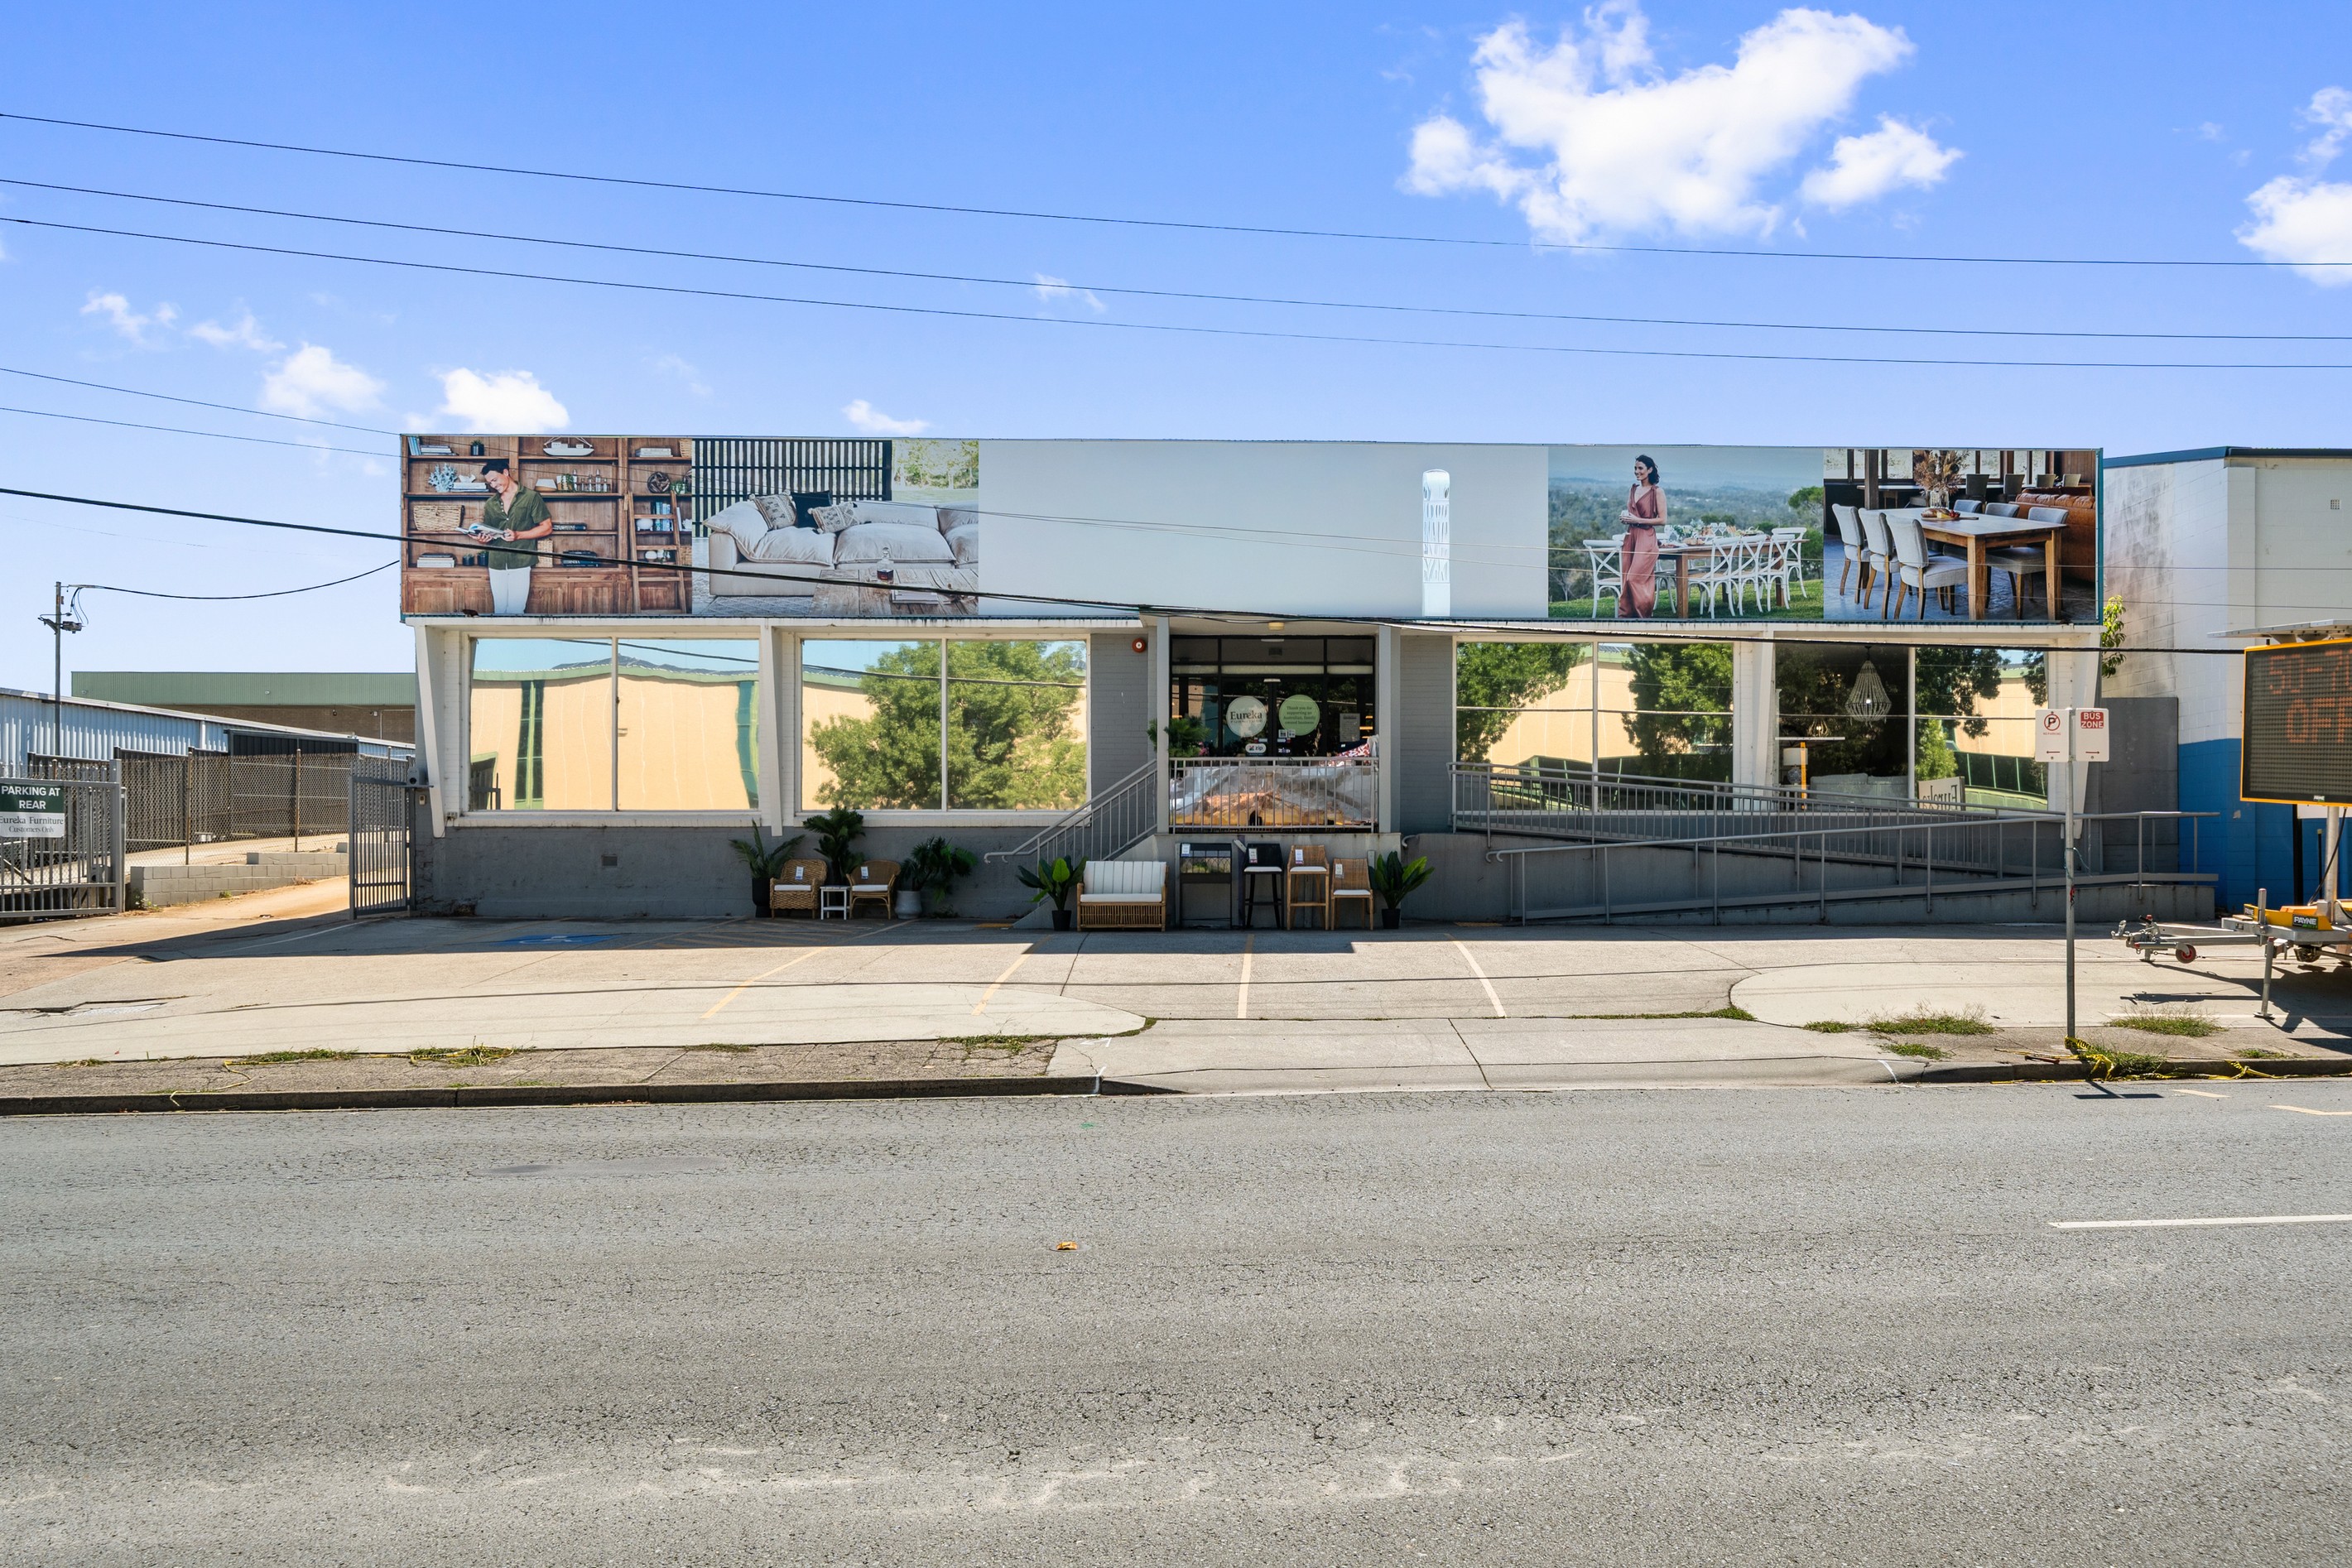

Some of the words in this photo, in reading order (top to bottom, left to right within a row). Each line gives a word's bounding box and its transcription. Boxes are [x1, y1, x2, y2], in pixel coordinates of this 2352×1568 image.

[1230, 710, 1263, 719] Eureka
[2287, 698, 2352, 743] OFF
[1, 786, 47, 796] PARKING
[48, 787, 60, 796] AT
[18, 800, 46, 810] REAR
[29, 816, 64, 825] Furniture
[2293, 916, 2317, 926] PAYNE
